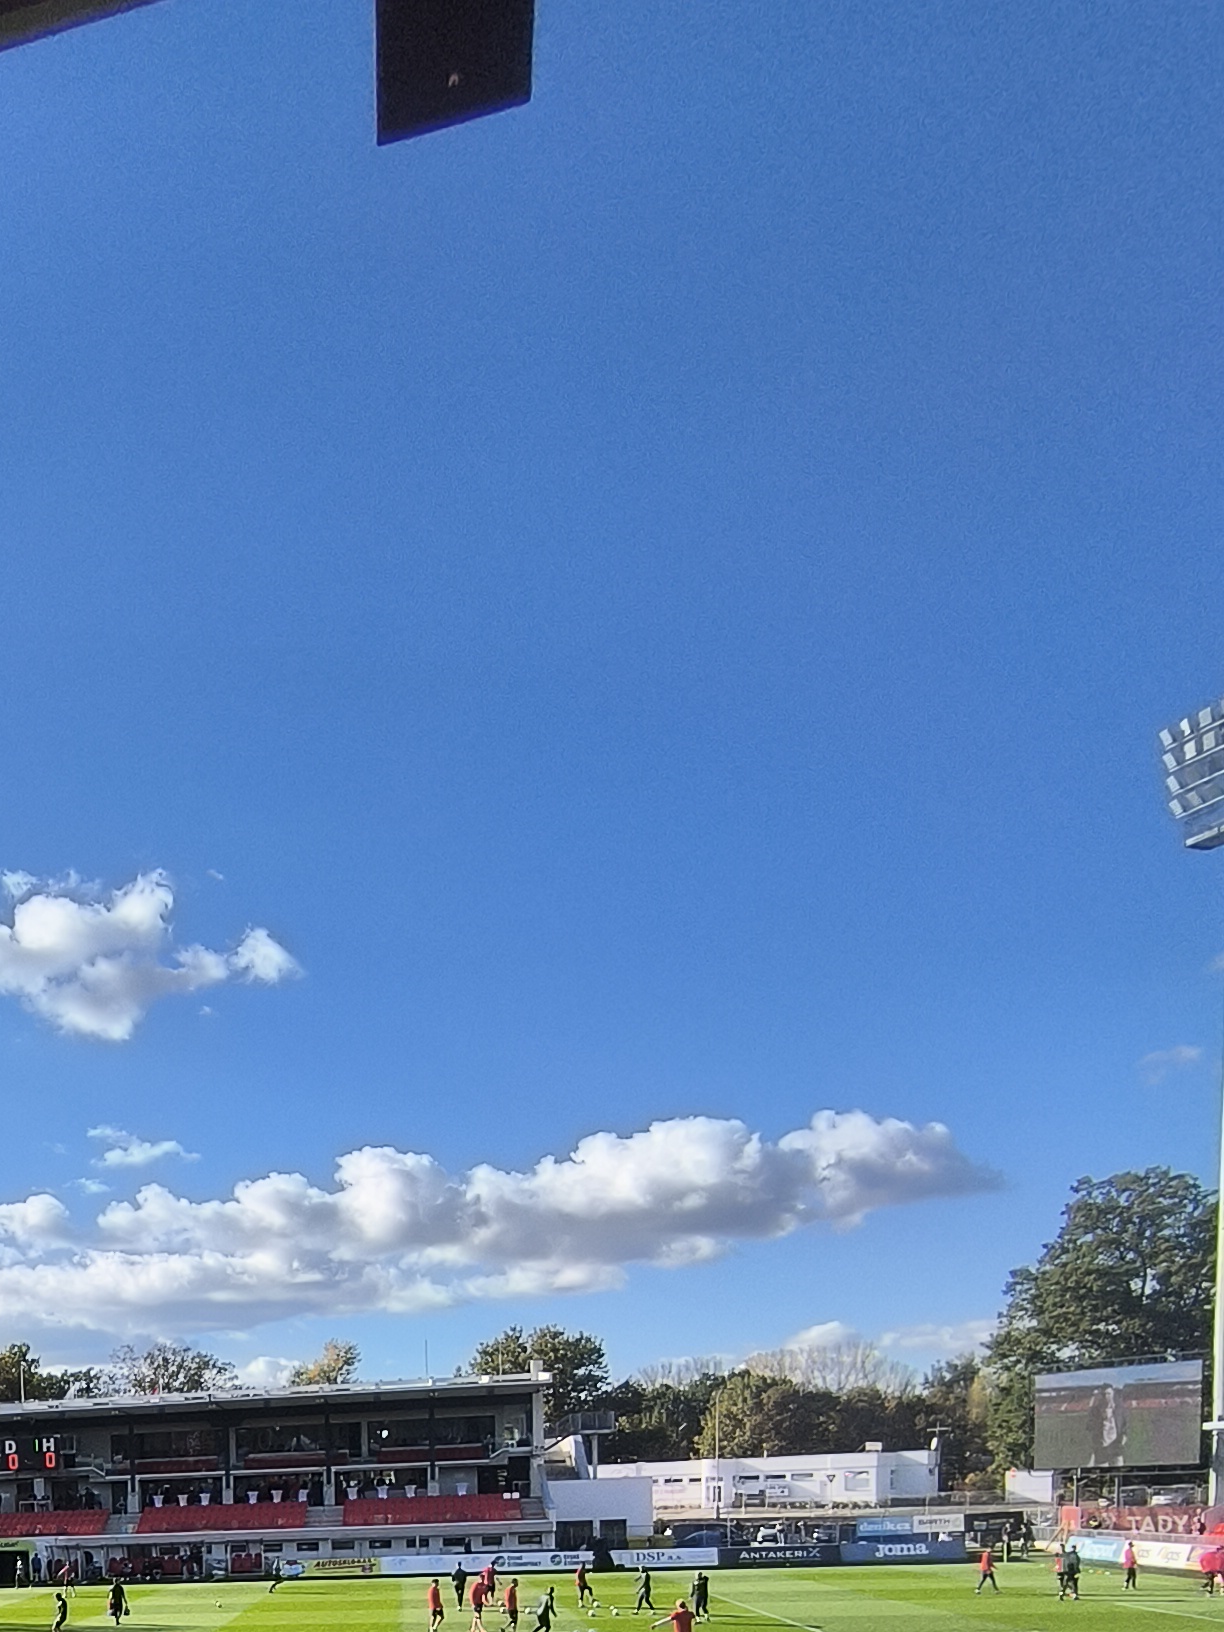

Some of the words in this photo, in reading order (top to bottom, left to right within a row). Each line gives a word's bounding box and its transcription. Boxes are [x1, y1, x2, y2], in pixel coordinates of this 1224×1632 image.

[5, 1440, 16, 1454] D
[43, 1438, 54, 1452] H
[9, 1454, 18, 1469] 0
[46, 1452, 55, 1468] 0
[1126, 1514, 1189, 1533] TADY
[635, 1551, 666, 1563] DSP
